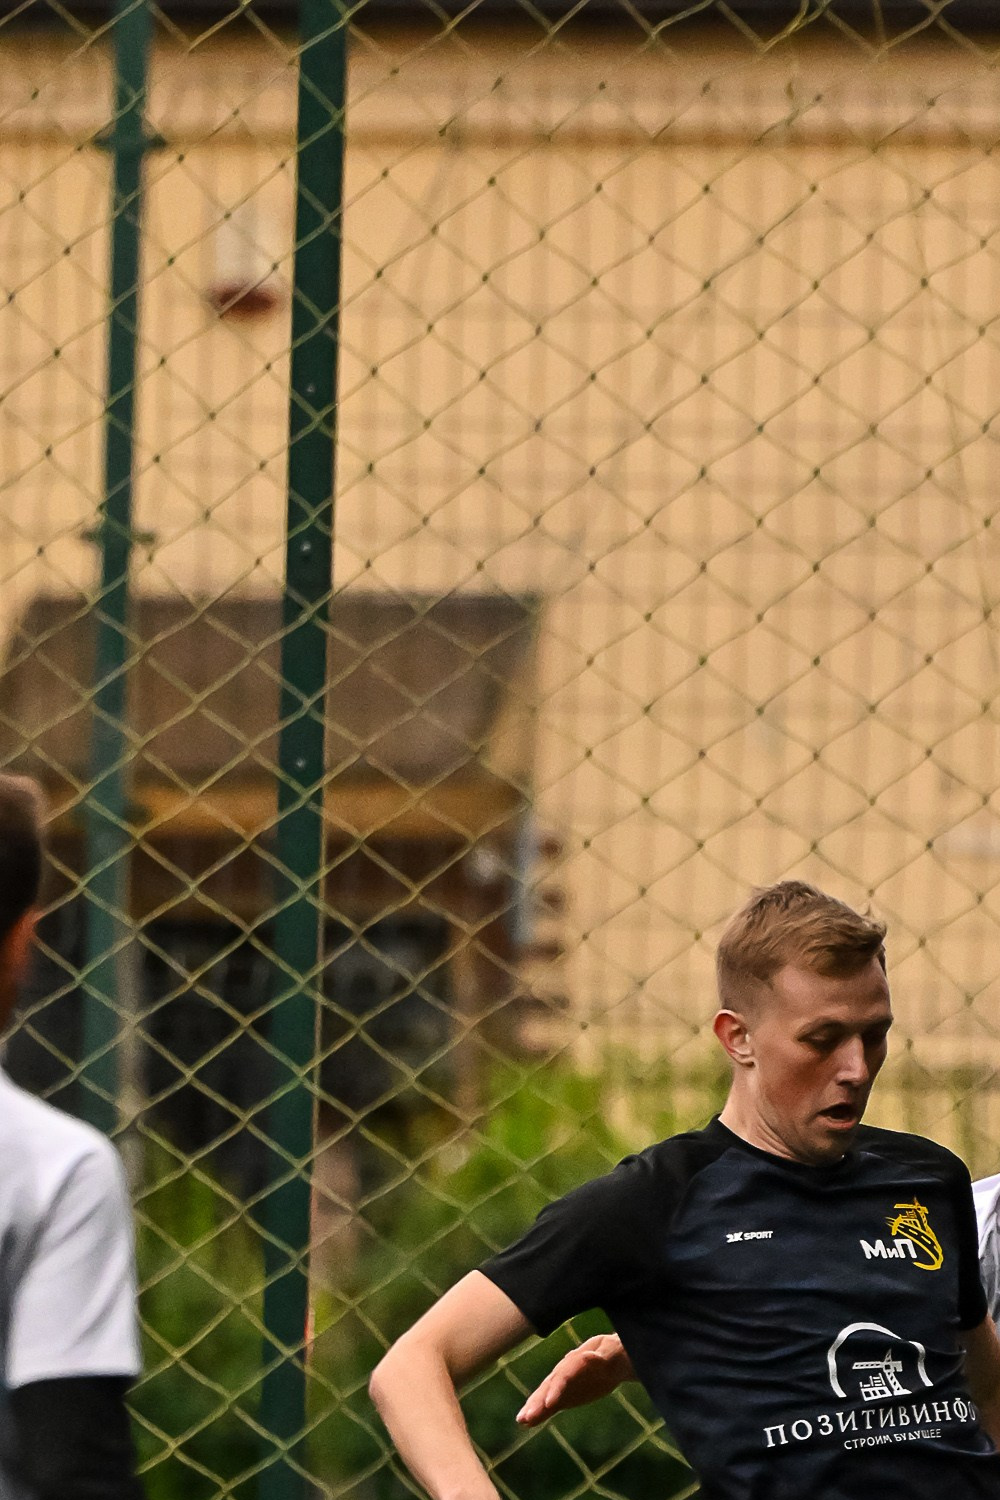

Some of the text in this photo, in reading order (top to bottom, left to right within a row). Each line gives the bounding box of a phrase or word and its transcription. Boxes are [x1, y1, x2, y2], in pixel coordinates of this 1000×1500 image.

[744, 1230, 773, 1241] SPORT
[859, 1238, 918, 1260] МиП
[844, 1428, 942, 1451] СТРОИМ БУДУЩЕЕ
